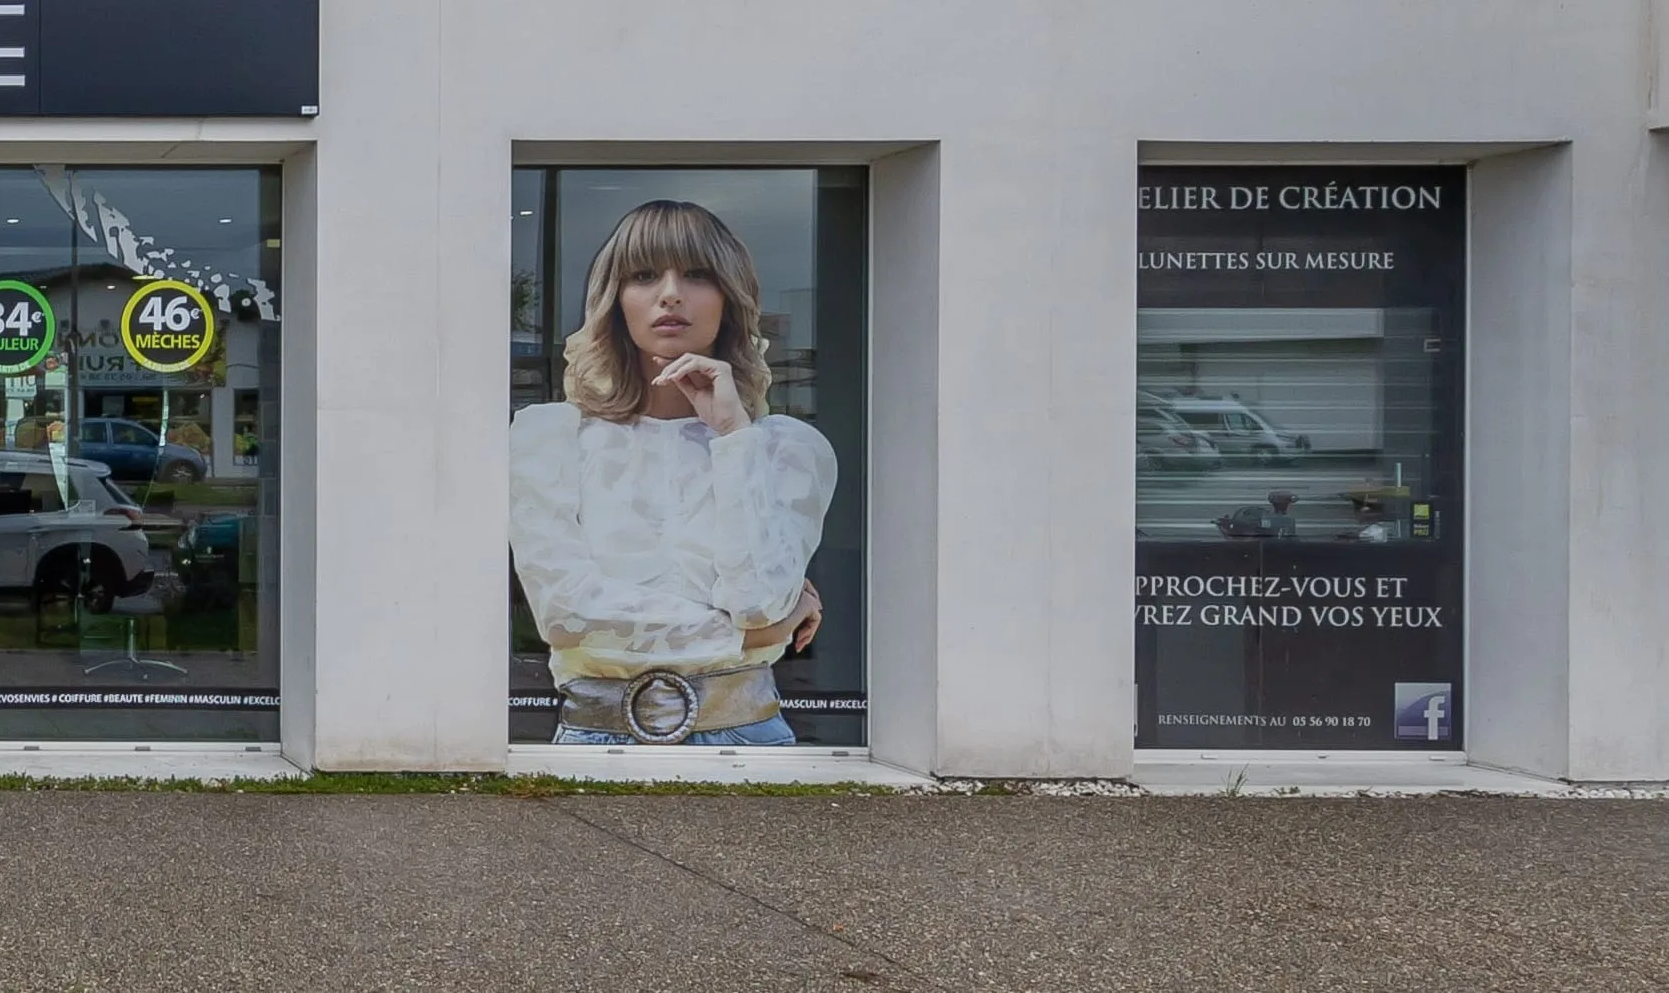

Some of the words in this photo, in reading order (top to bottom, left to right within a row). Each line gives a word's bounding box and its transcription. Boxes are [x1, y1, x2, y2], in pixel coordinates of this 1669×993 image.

[1230, 186, 1270, 210] DE
[1279, 180, 1442, 210] CRÉATION
[1138, 252, 1249, 270] LUNETTES
[1256, 252, 1300, 270] SUR
[1304, 252, 1395, 270] MESURE
[135, 331, 201, 349] MÈCHES
[1375, 577, 1409, 598] ET
[1200, 604, 1302, 627] GRAND
[1309, 606, 1364, 627] VOS
[1371, 607, 1443, 628] YEUX
[58, 693, 103, 703] COIFFURE
[104, 693, 144, 704] #BEAUTE
[145, 693, 188, 704] #FEMININ
[189, 694, 241, 705] #MASCULIN
[1157, 714, 1267, 727] RENSEIGNEMENTS
[1269, 716, 1287, 727] AU
[1292, 716, 1307, 727] 05
[1308, 716, 1323, 727] 56
[1324, 716, 1339, 727] 90
[1341, 716, 1355, 727] 18
[1357, 716, 1371, 727] 70
